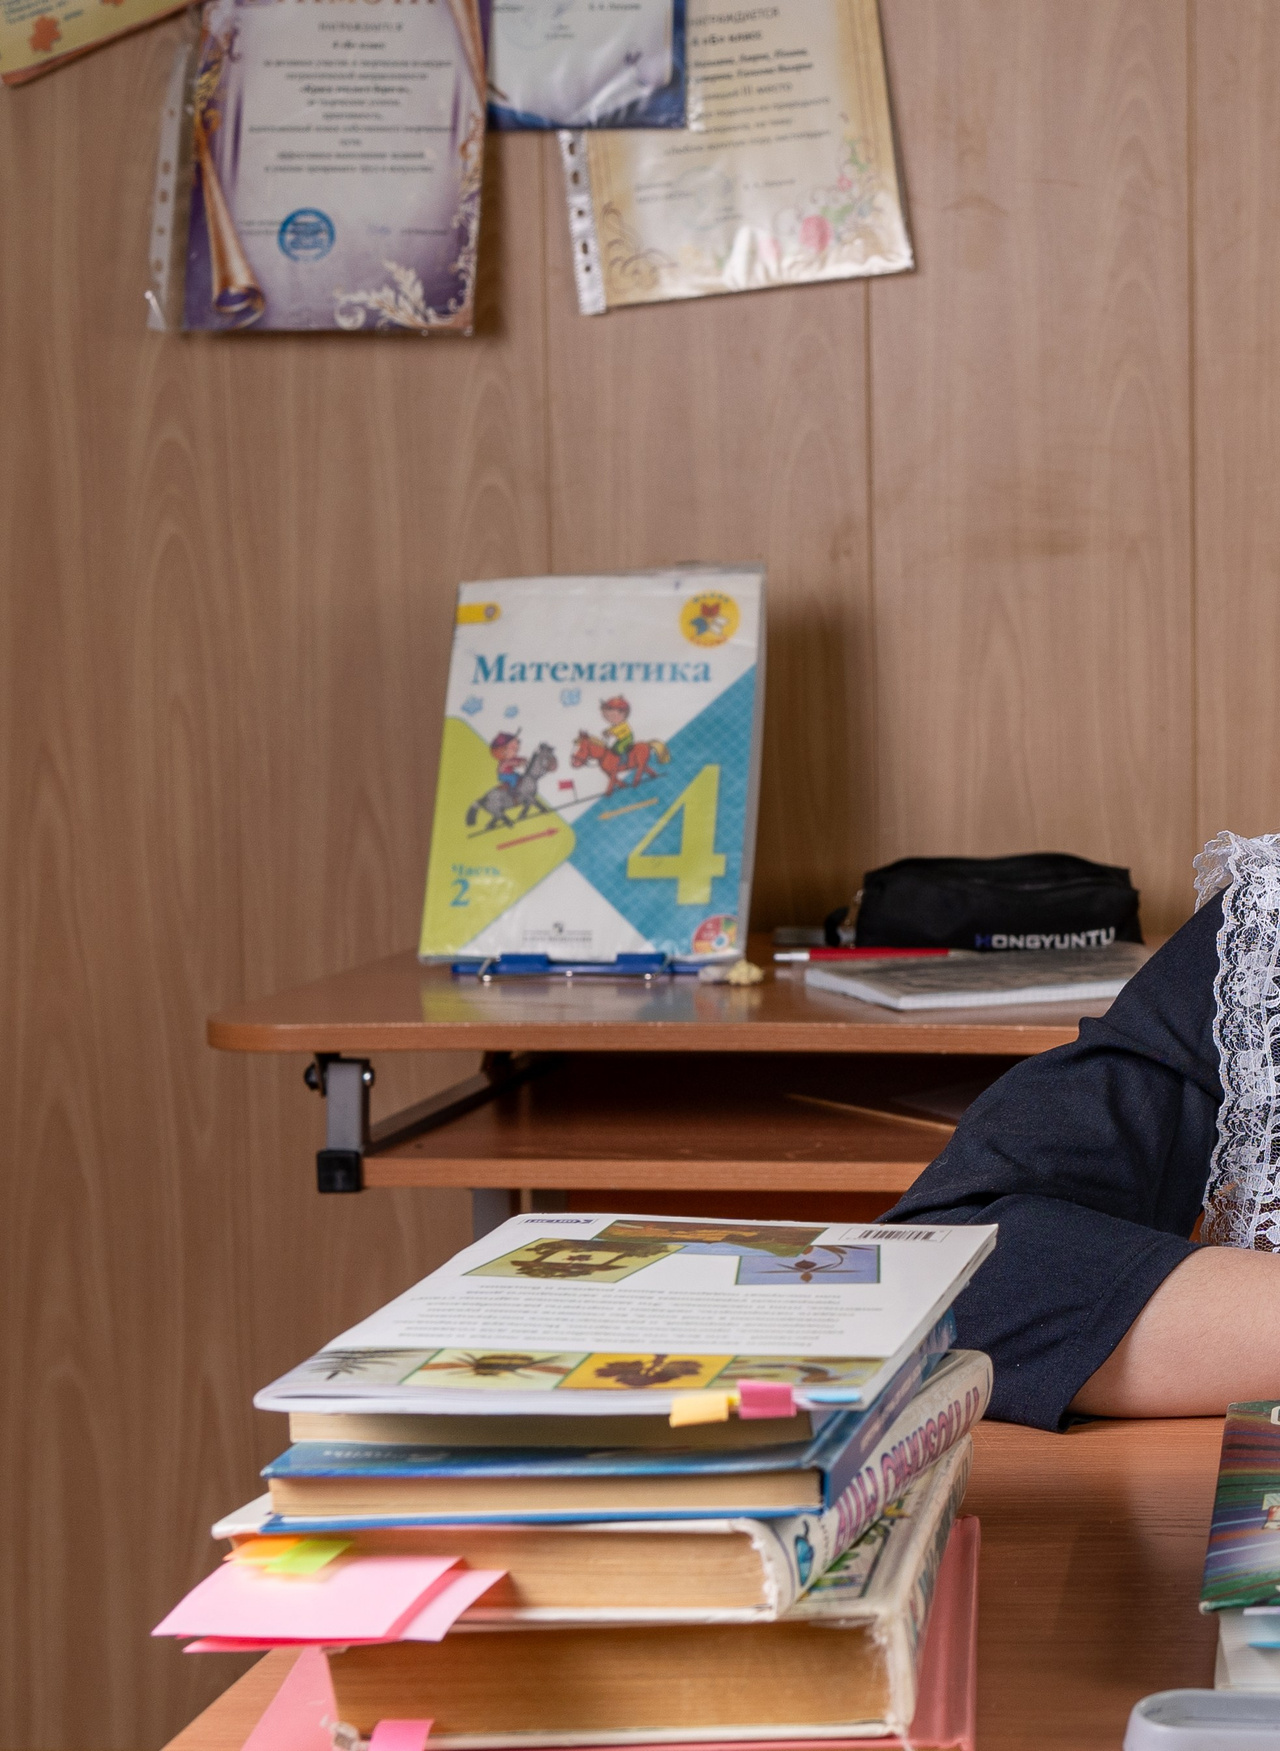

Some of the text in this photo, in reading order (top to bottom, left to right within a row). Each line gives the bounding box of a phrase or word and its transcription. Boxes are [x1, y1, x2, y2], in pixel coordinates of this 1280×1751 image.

[472, 653, 712, 685] Математика
[627, 763, 727, 906] 4
[449, 878, 471, 907] 2
[975, 926, 1115, 949] HONGYUNTU
